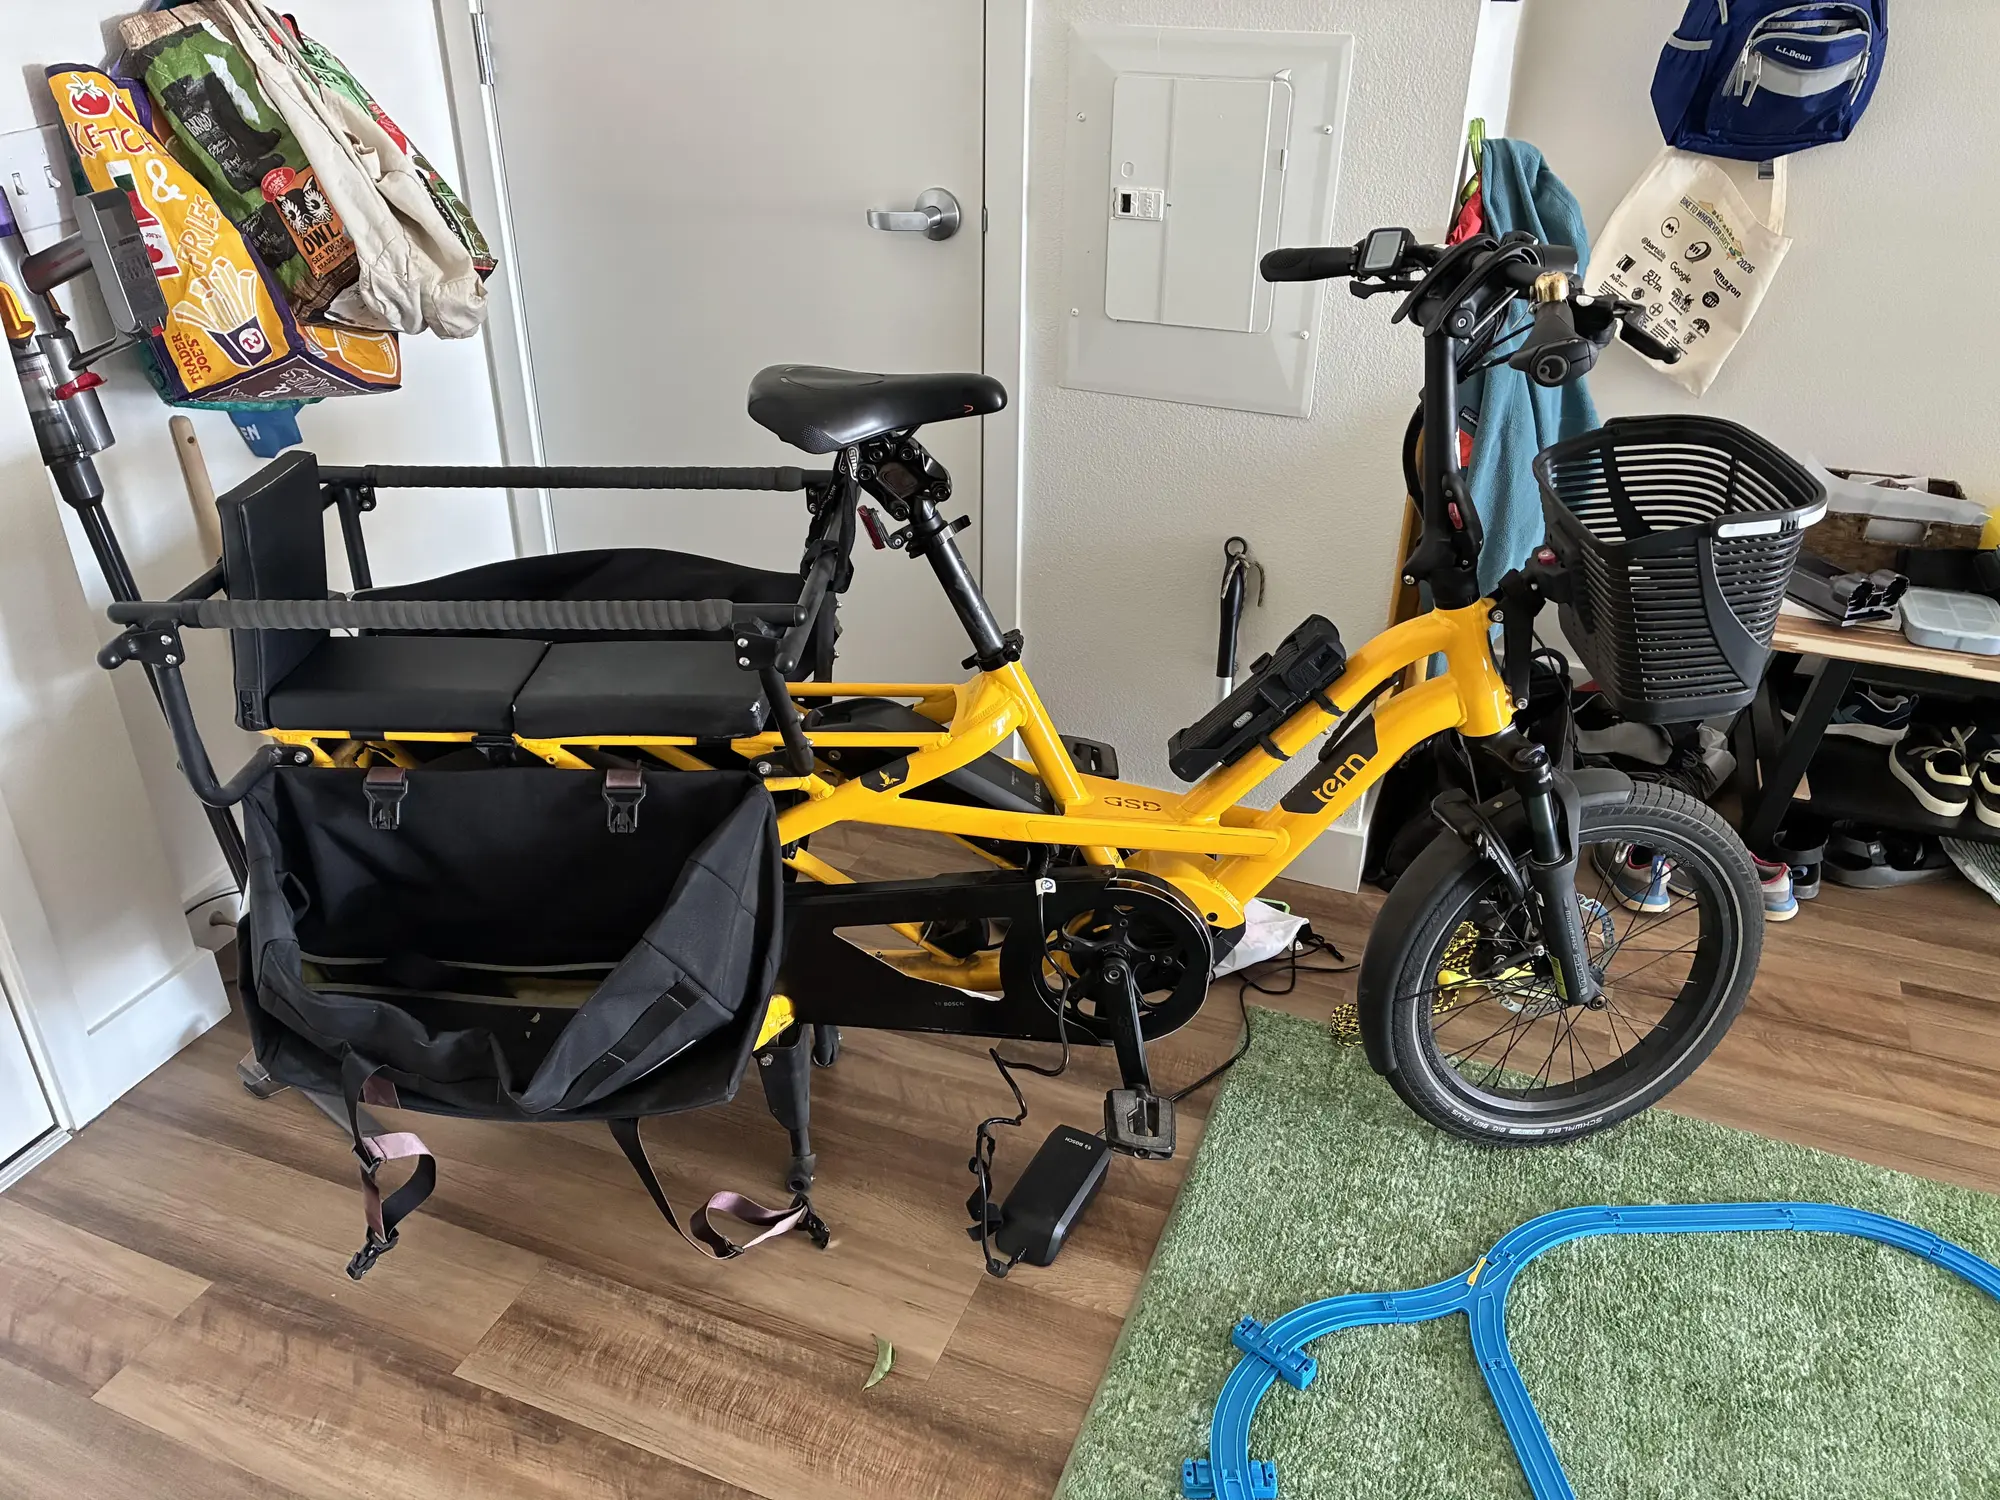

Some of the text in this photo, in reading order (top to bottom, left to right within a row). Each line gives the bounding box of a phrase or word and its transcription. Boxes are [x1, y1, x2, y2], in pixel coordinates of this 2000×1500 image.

[1775, 45, 1812, 62] L.L.Bean
[145, 159, 187, 203] &
[1680, 196, 1731, 249] BIKE TO WHEREVER DAYS
[176, 195, 222, 272] FRIES
[302, 223, 341, 255] OWL
[1641, 237, 1667, 260] @bartable
[1688, 243, 1702, 255] 511
[311, 252, 325, 265] SEE
[1736, 257, 1756, 274] 2026
[1647, 269, 1661, 282] 511
[1670, 261, 1692, 284] Google
[1642, 275, 1662, 293] CCTA
[1713, 267, 1742, 299] amazon
[241, 332, 262, 350] TJ
[172, 332, 203, 385] TRADER
[1311, 753, 1370, 803] tern
[1104, 796, 1162, 812] GSD
[1451, 1108, 1470, 1123] PLUS
[1472, 1120, 1489, 1129] BEN
[1492, 1125, 1506, 1133] BIG
[1547, 1116, 1603, 1134] SCHWALBE
[1064, 1136, 1084, 1149] BOSCH
